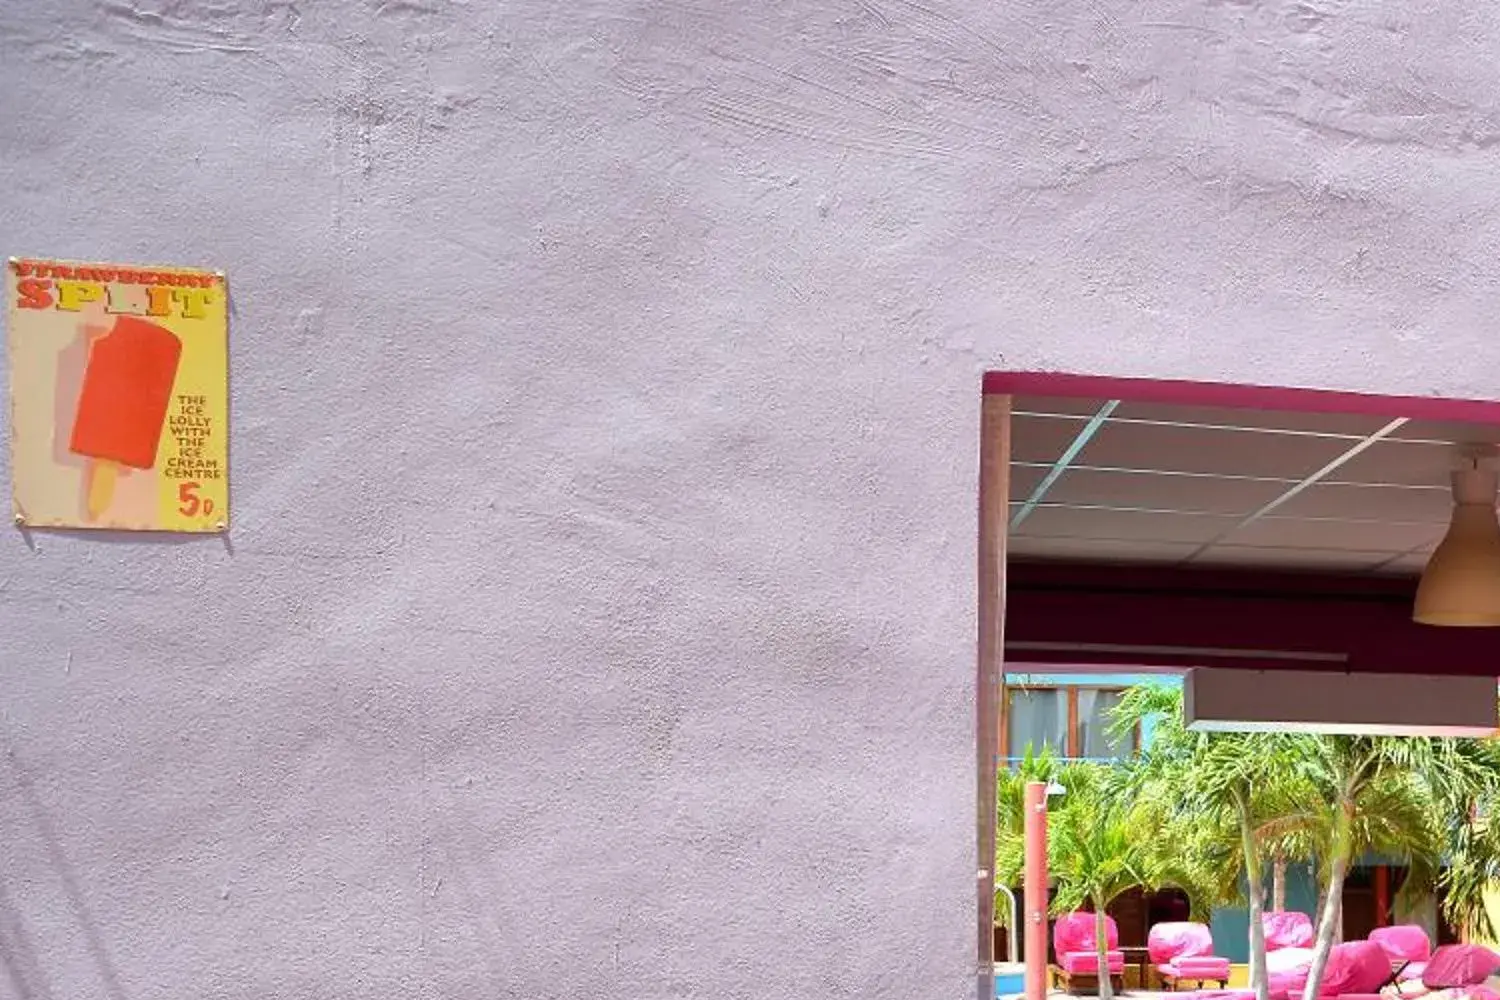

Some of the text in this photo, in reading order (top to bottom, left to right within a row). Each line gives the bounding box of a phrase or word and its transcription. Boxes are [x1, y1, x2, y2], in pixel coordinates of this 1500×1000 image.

[17, 279, 213, 319] SPLIT
[177, 395, 207, 405] THE
[181, 405, 203, 415] ICE
[169, 415, 212, 426] LOLLY
[169, 426, 211, 437] WITH
[176, 437, 205, 446] THE
[179, 447, 202, 457] ICE
[167, 457, 217, 468] CREAM
[164, 467, 221, 479] CENTRE
